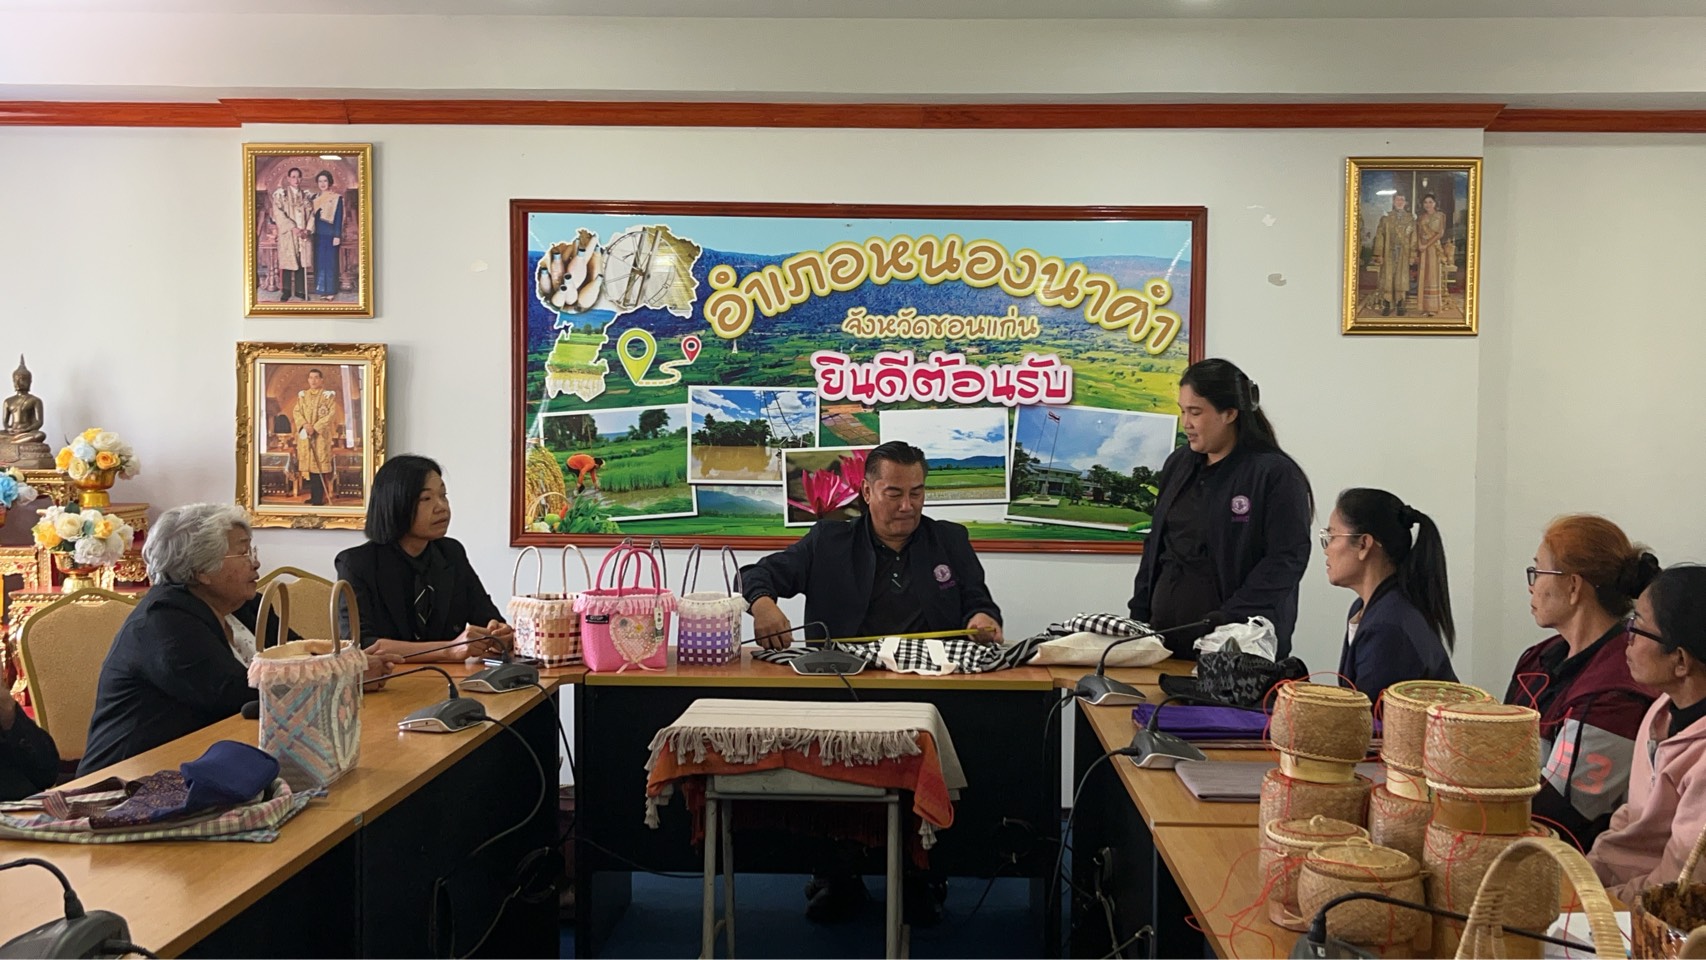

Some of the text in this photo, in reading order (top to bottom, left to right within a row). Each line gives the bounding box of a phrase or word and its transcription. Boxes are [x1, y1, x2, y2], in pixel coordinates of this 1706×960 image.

[708, 238, 1177, 350] อำเภอหนองนาคำ
[843, 307, 1039, 338] จังหวัดขอนแก่น
[814, 353, 1069, 402] ยินดีต้อนรับ
